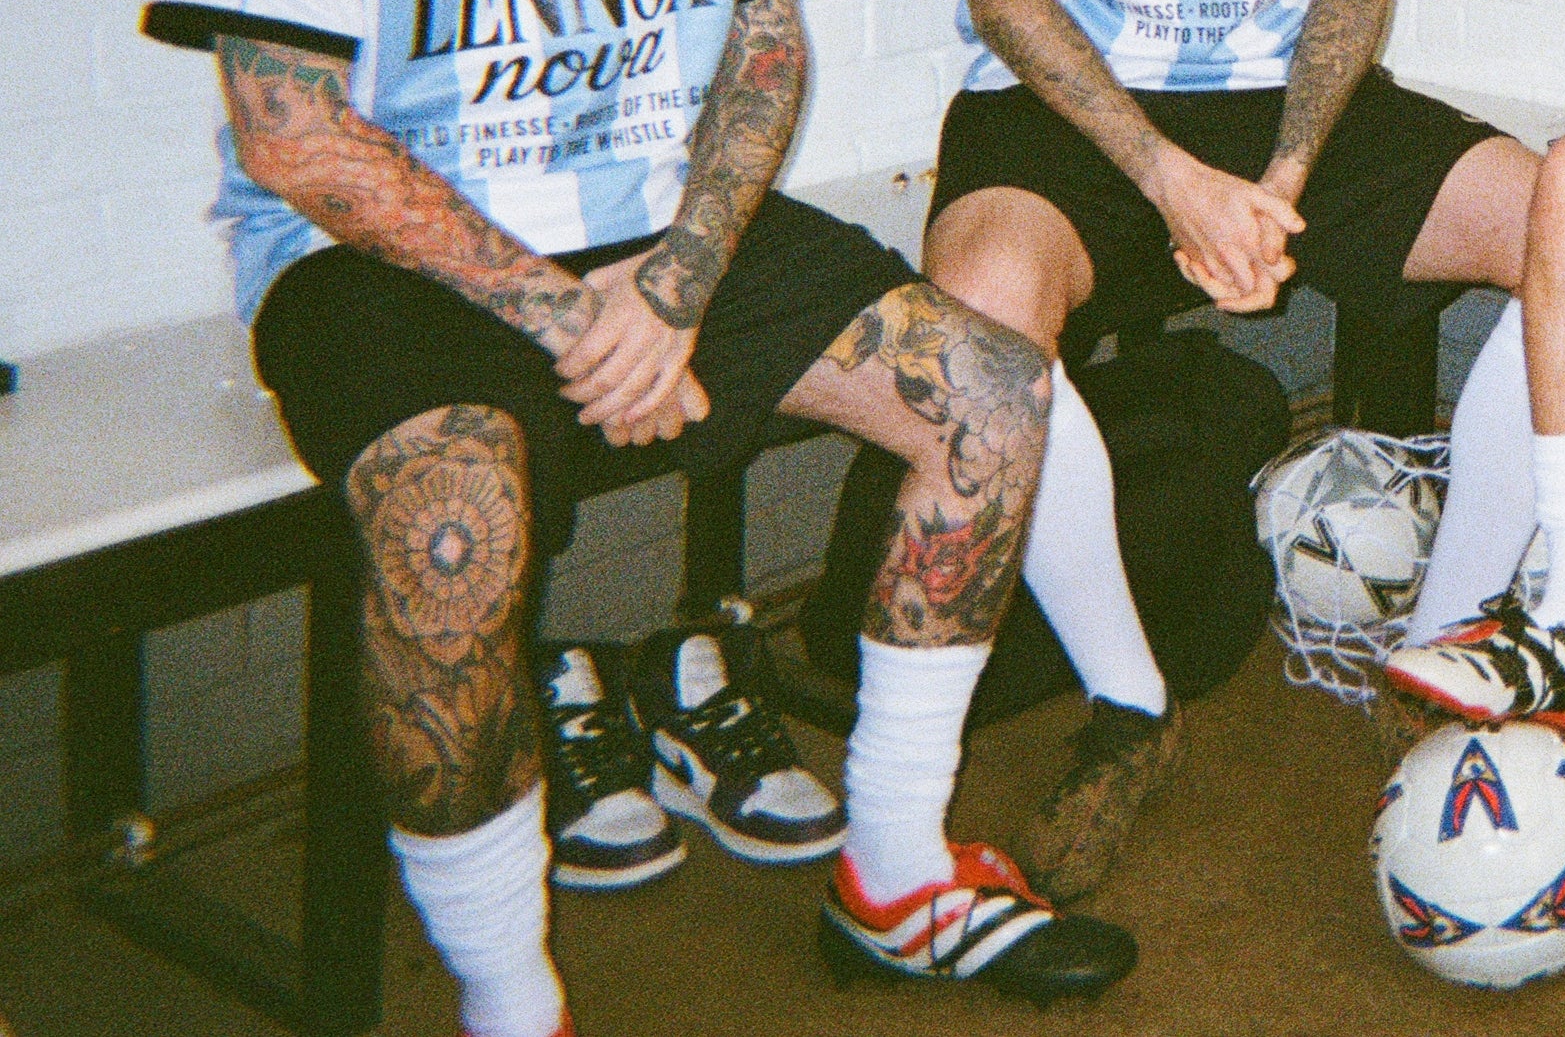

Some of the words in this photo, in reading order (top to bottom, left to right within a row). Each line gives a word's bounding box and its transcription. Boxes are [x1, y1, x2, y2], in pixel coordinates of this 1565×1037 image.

[1134, 20, 1171, 42] PLAY
[1173, 26, 1191, 45] TO
[1195, 25, 1227, 44] THE
[1198, 0, 1250, 20] ROOTS
[470, 28, 665, 105] nova
[459, 115, 557, 145] FINESSE
[623, 94, 643, 118] OF
[648, 87, 683, 112] THE
[478, 145, 531, 168] PLAY
[596, 119, 675, 152] WHISTLE
